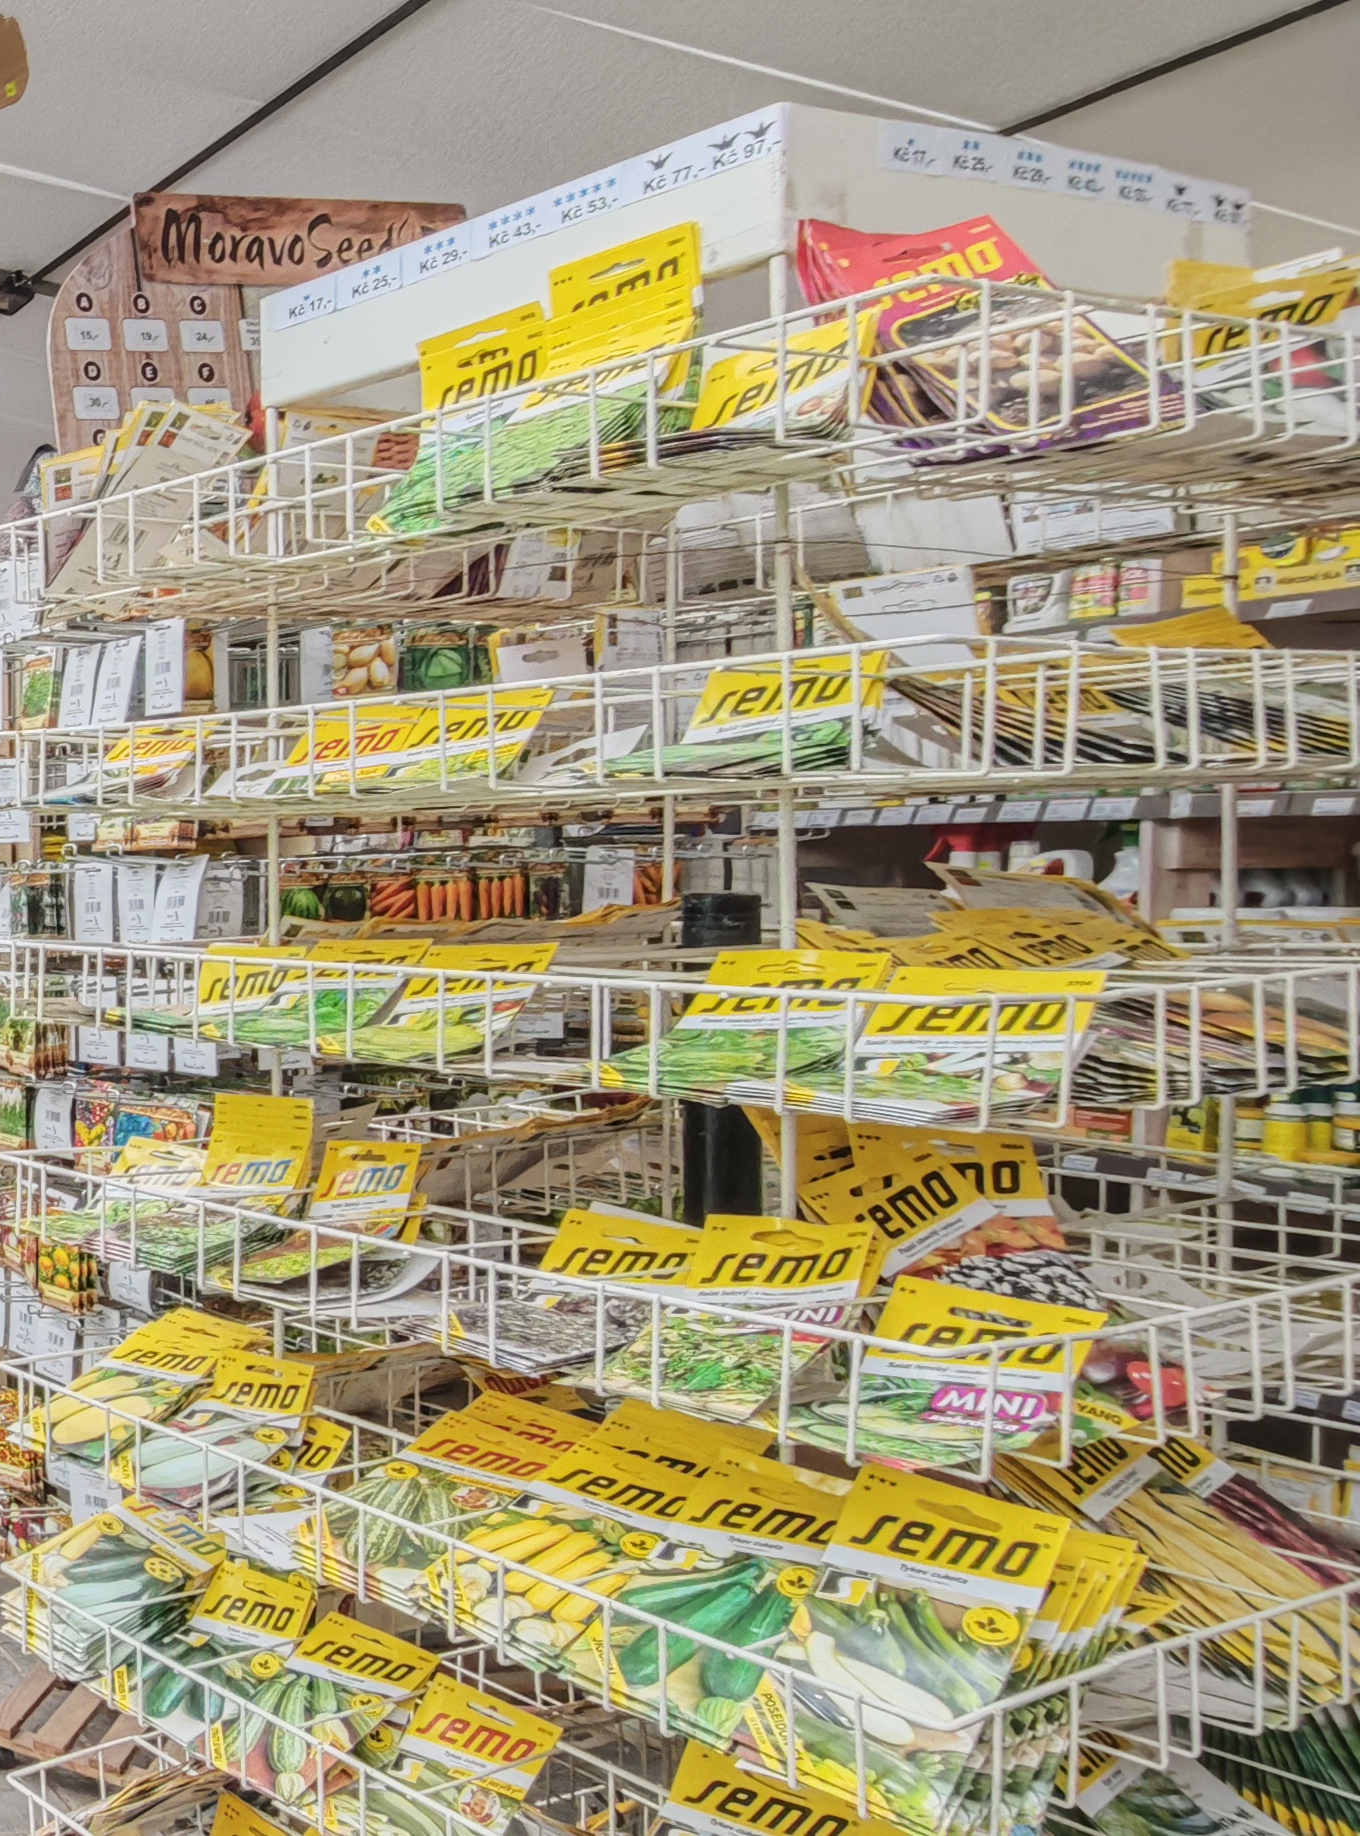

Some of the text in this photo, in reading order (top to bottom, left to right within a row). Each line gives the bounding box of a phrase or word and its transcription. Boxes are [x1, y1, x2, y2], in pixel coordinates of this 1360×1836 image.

[712, 150, 738, 170] Kč
[642, 164, 707, 195] Kč 77,-
[561, 195, 619, 225] Kč 53,-
[488, 222, 541, 249] Kč 43,-
[419, 248, 468, 275] Kč 29,-
[351, 275, 397, 299] Kč 25,-
[288, 298, 332, 320] Kč 17,-
[854, 1169, 959, 1240] emo
[699, 1246, 854, 1285] semo
[113, 1347, 210, 1373] semo
[211, 1380, 302, 1411] semo
[416, 1437, 549, 1478] semo
[546, 1467, 688, 1518] semo
[848, 1513, 1042, 1578] semo
[203, 1593, 296, 1632] semo
[301, 1640, 418, 1682] semo
[415, 1712, 538, 1763] semo
[684, 1779, 852, 1836] semo
